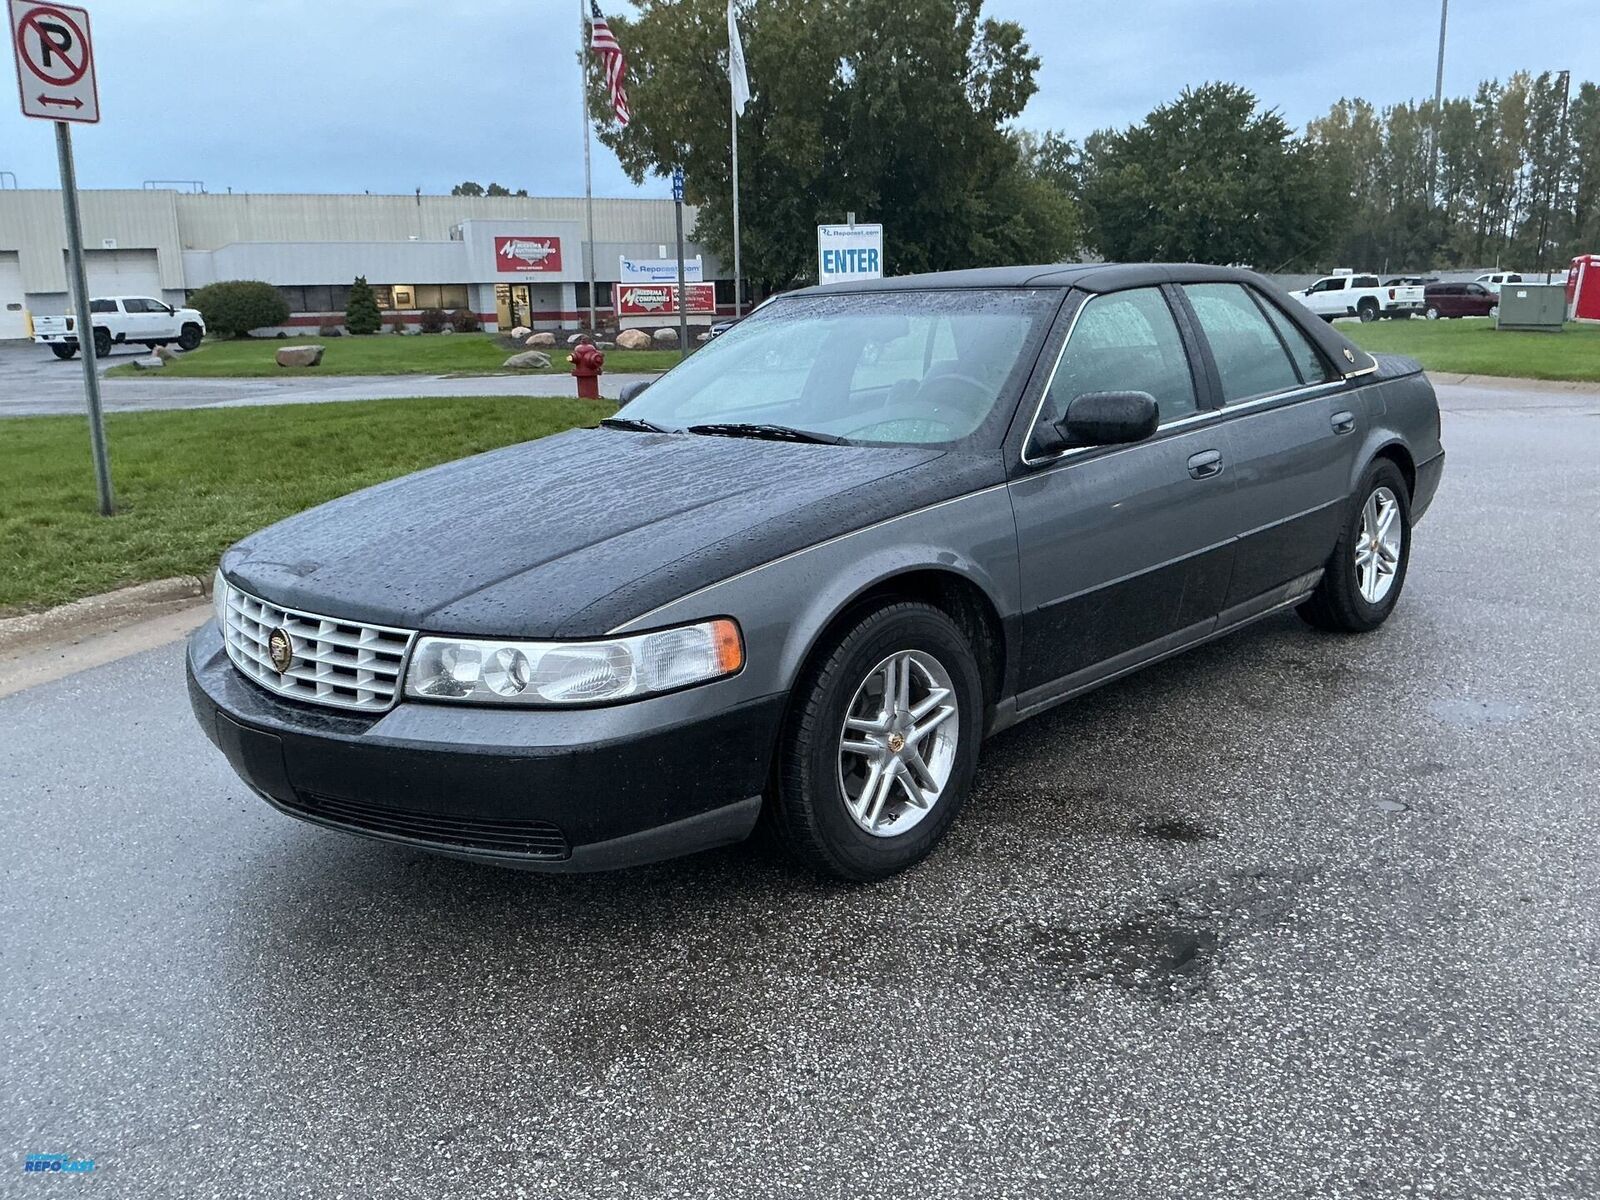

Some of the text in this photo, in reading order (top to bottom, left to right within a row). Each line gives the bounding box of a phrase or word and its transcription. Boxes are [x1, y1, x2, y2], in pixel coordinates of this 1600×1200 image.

[674, 189, 683, 199] 12
[823, 248, 879, 274] ENTER
[640, 265, 699, 273] Repocastcom
